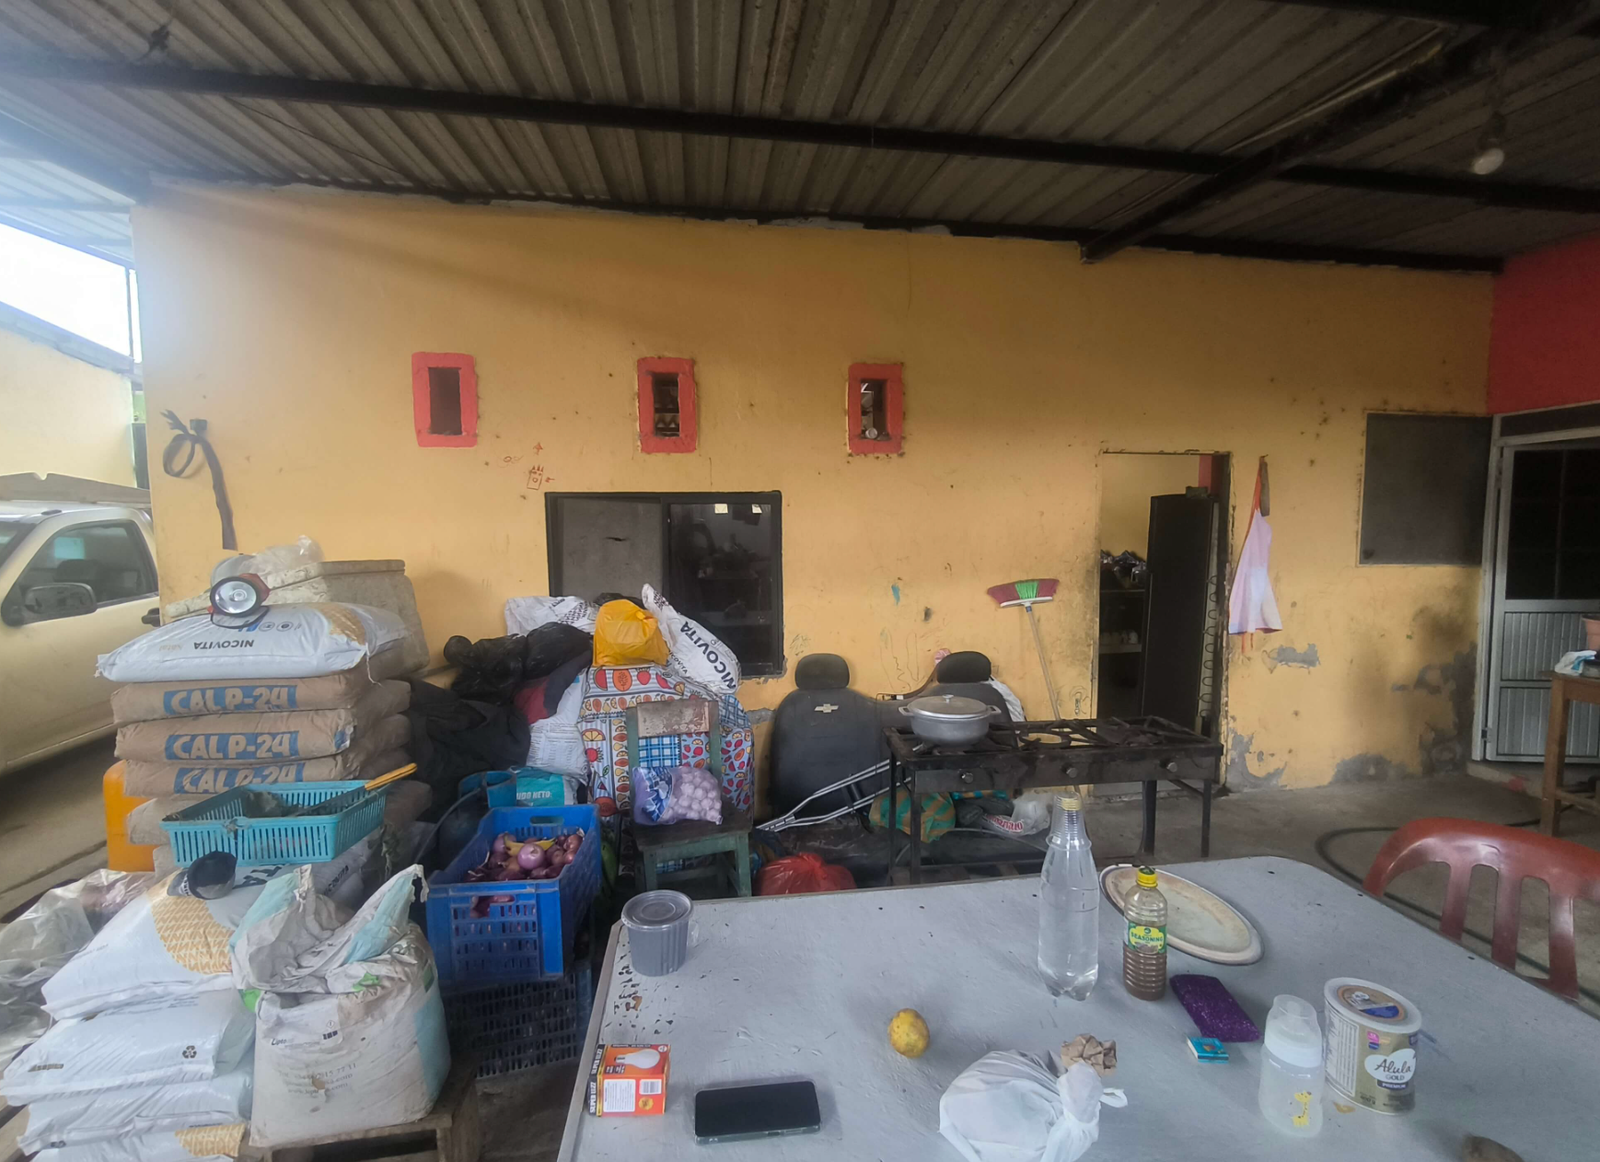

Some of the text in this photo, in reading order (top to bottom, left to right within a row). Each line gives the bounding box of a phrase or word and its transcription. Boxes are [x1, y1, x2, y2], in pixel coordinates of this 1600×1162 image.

[193, 639, 255, 650] NICOVITA
[680, 621, 737, 690] NICOVITA
[669, 651, 688, 675] ICOVITA
[171, 686, 289, 714] CAL P-24
[173, 733, 291, 759] CAL P-24
[183, 768, 230, 793] CAL
[1374, 1058, 1411, 1074] Alula
[1385, 1073, 1405, 1081] GOLD
